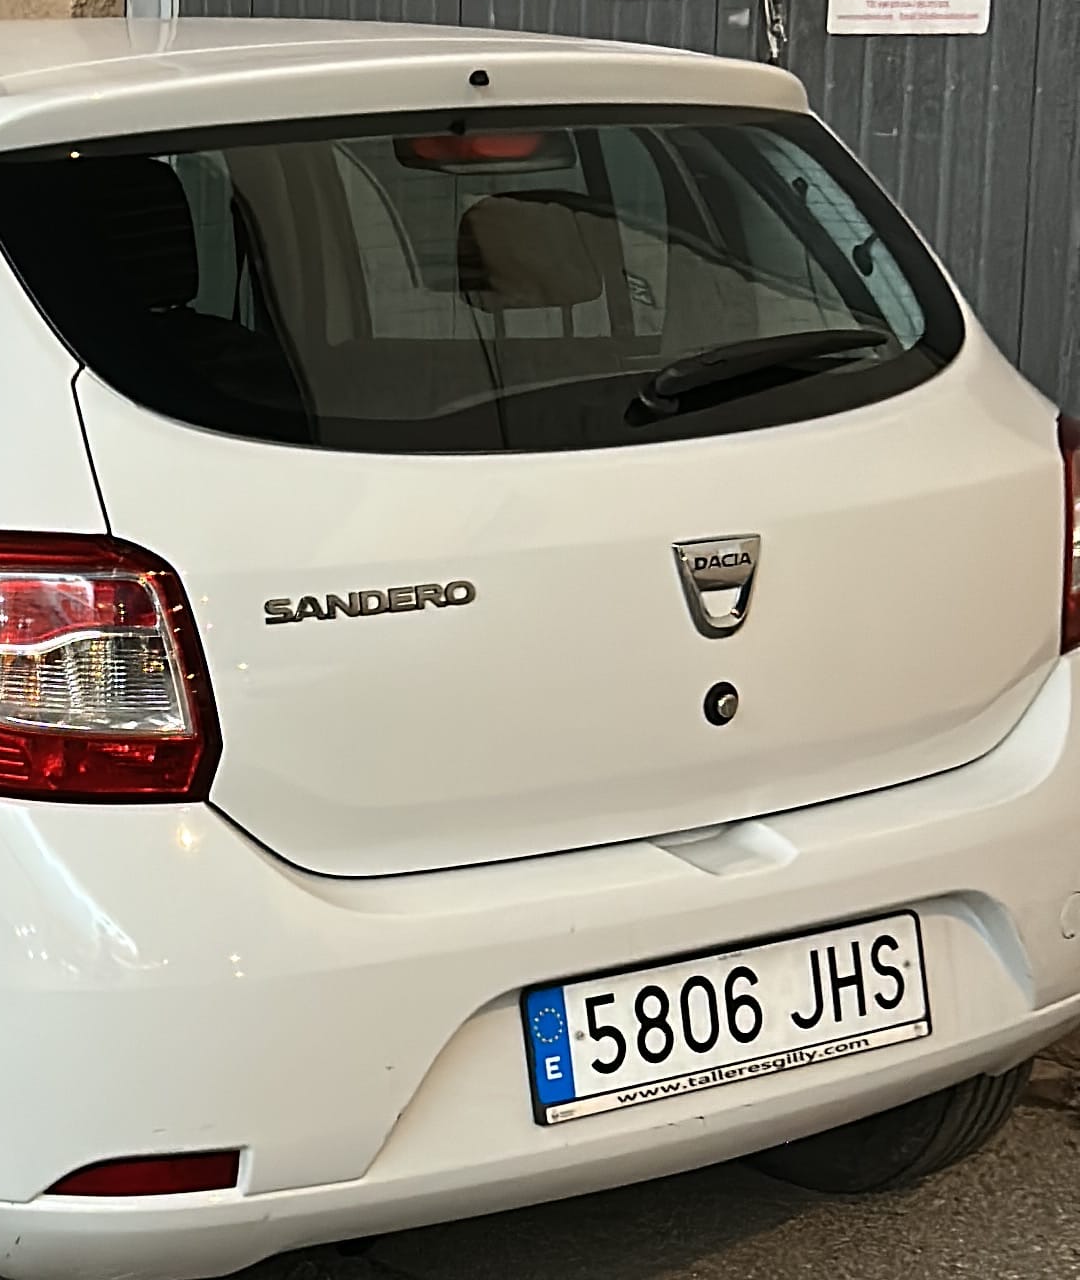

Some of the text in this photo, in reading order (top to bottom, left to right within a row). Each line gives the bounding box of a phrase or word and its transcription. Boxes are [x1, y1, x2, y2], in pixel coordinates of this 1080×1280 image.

[693, 551, 752, 572] DACIA
[264, 580, 476, 625] SANDERO
[585, 934, 905, 1074] 5806 JHS
[546, 1055, 563, 1080] E
[617, 1037, 870, 1104] www.talleresgilly.com
